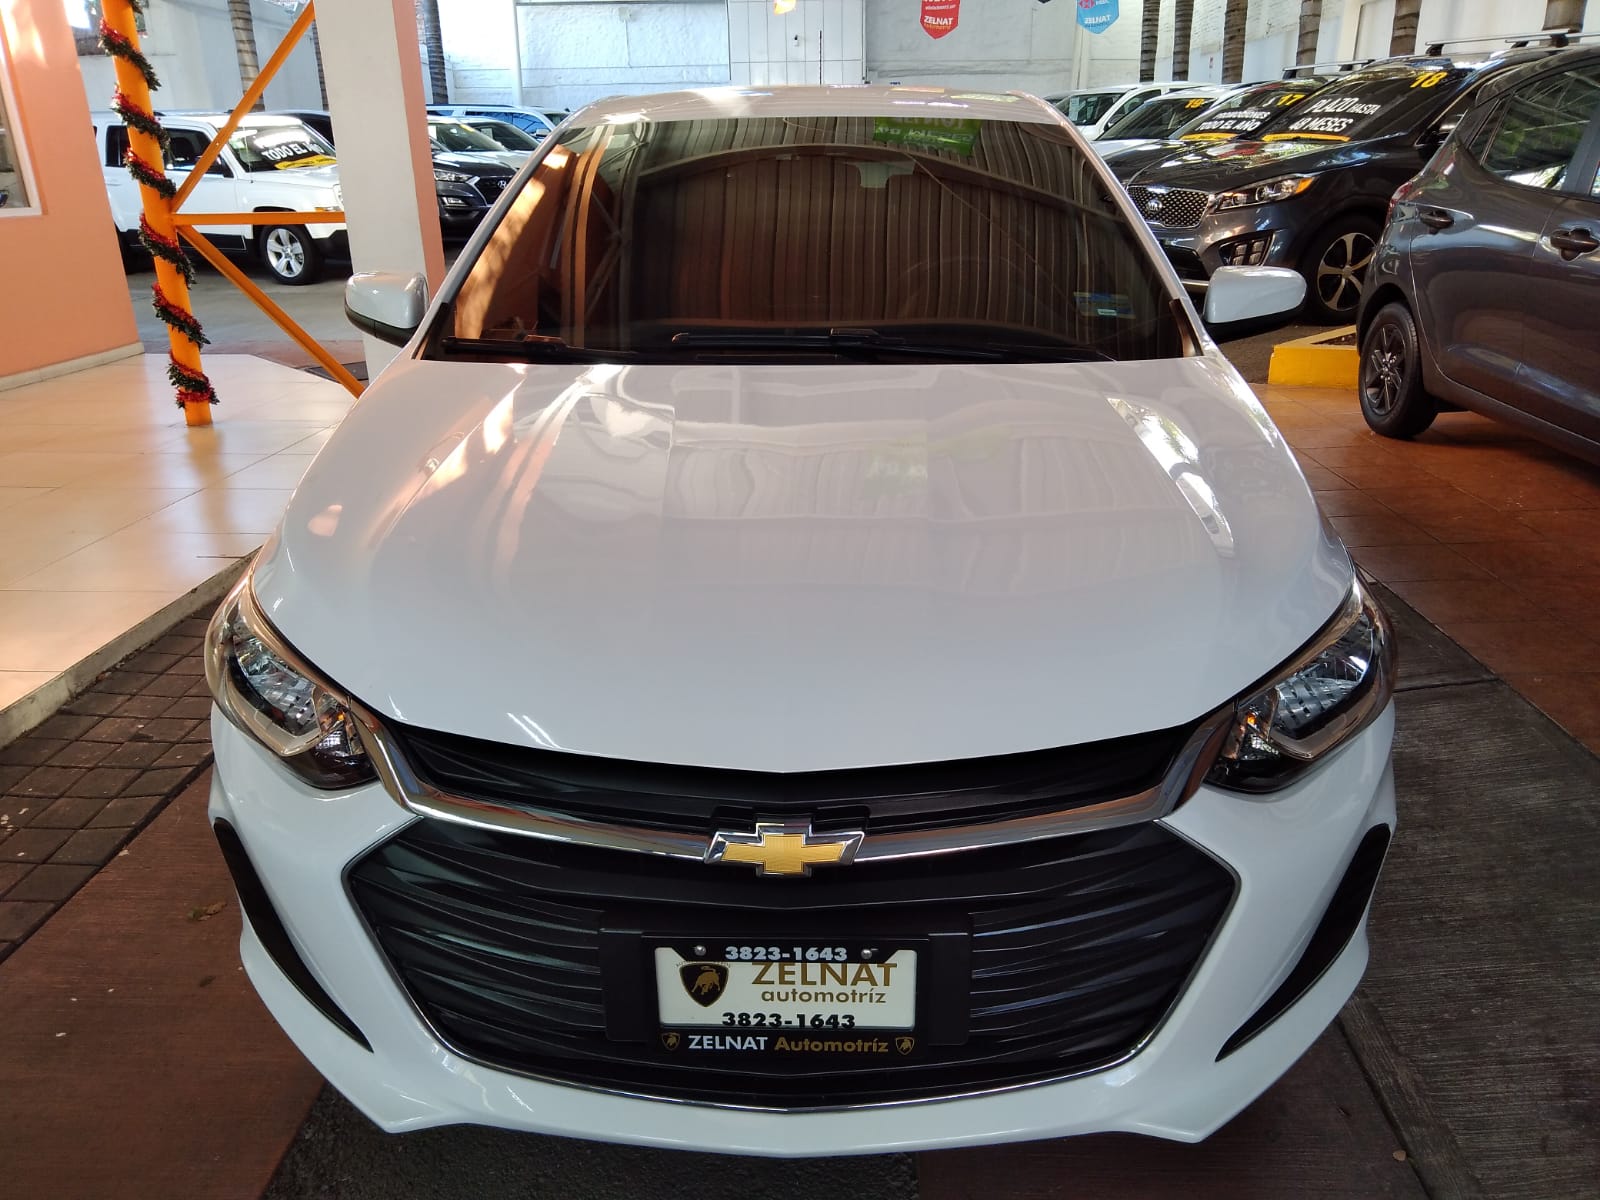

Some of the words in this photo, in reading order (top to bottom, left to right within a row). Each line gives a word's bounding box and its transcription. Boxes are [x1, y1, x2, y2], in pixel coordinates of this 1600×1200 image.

[924, 15, 954, 25] ZELNAT
[1410, 71, 1449, 88] 18
[1276, 93, 1305, 107] 17
[1305, 97, 1359, 114] PLAZO
[1348, 104, 1381, 115] HASTA
[1304, 117, 1354, 132] MESES
[261, 144, 293, 160] TODO
[288, 143, 308, 155] EL
[725, 946, 848, 961] 3823-1643
[751, 962, 898, 986] ZELNAT
[761, 988, 886, 1003] automotríz
[722, 1012, 856, 1029] 3823-1643
[688, 1035, 768, 1051] ZELNAT
[775, 1037, 889, 1053] Automotríz
